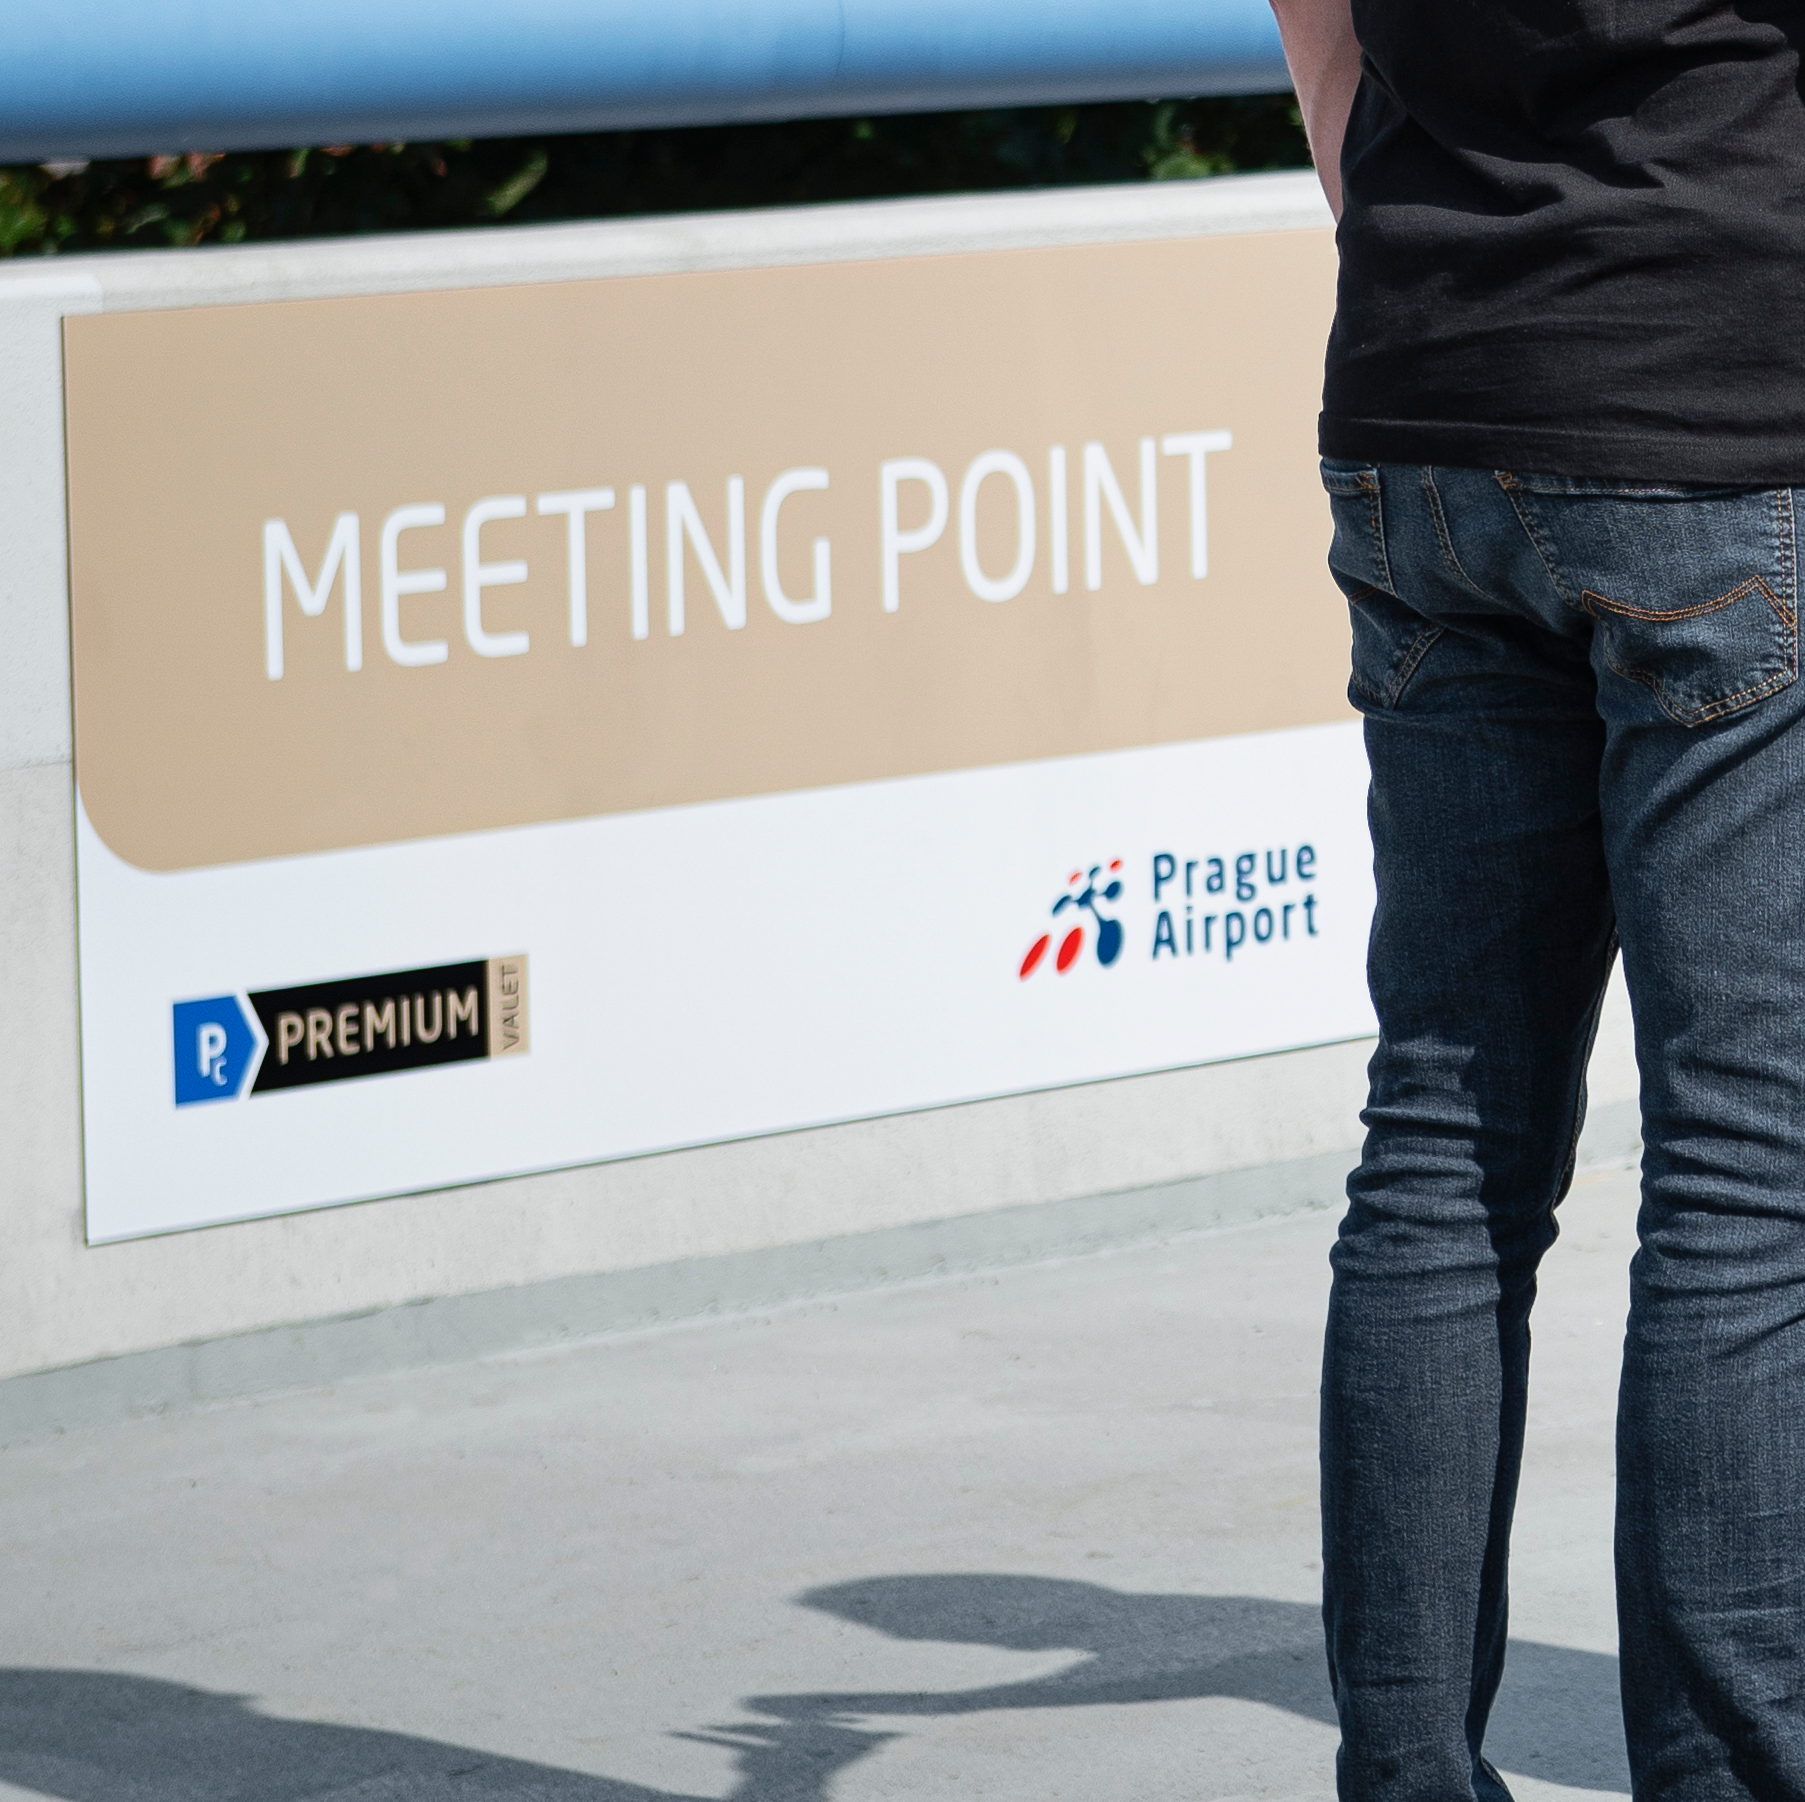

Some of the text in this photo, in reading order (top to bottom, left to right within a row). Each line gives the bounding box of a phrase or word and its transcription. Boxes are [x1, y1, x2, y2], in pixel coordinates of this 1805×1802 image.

[263, 429, 1233, 681] MEETING POINT
[1152, 843, 1317, 902] Prague
[1151, 894, 1319, 962] Airport
[277, 984, 480, 1066] PREMIUM
[501, 963, 521, 1052] VALET
